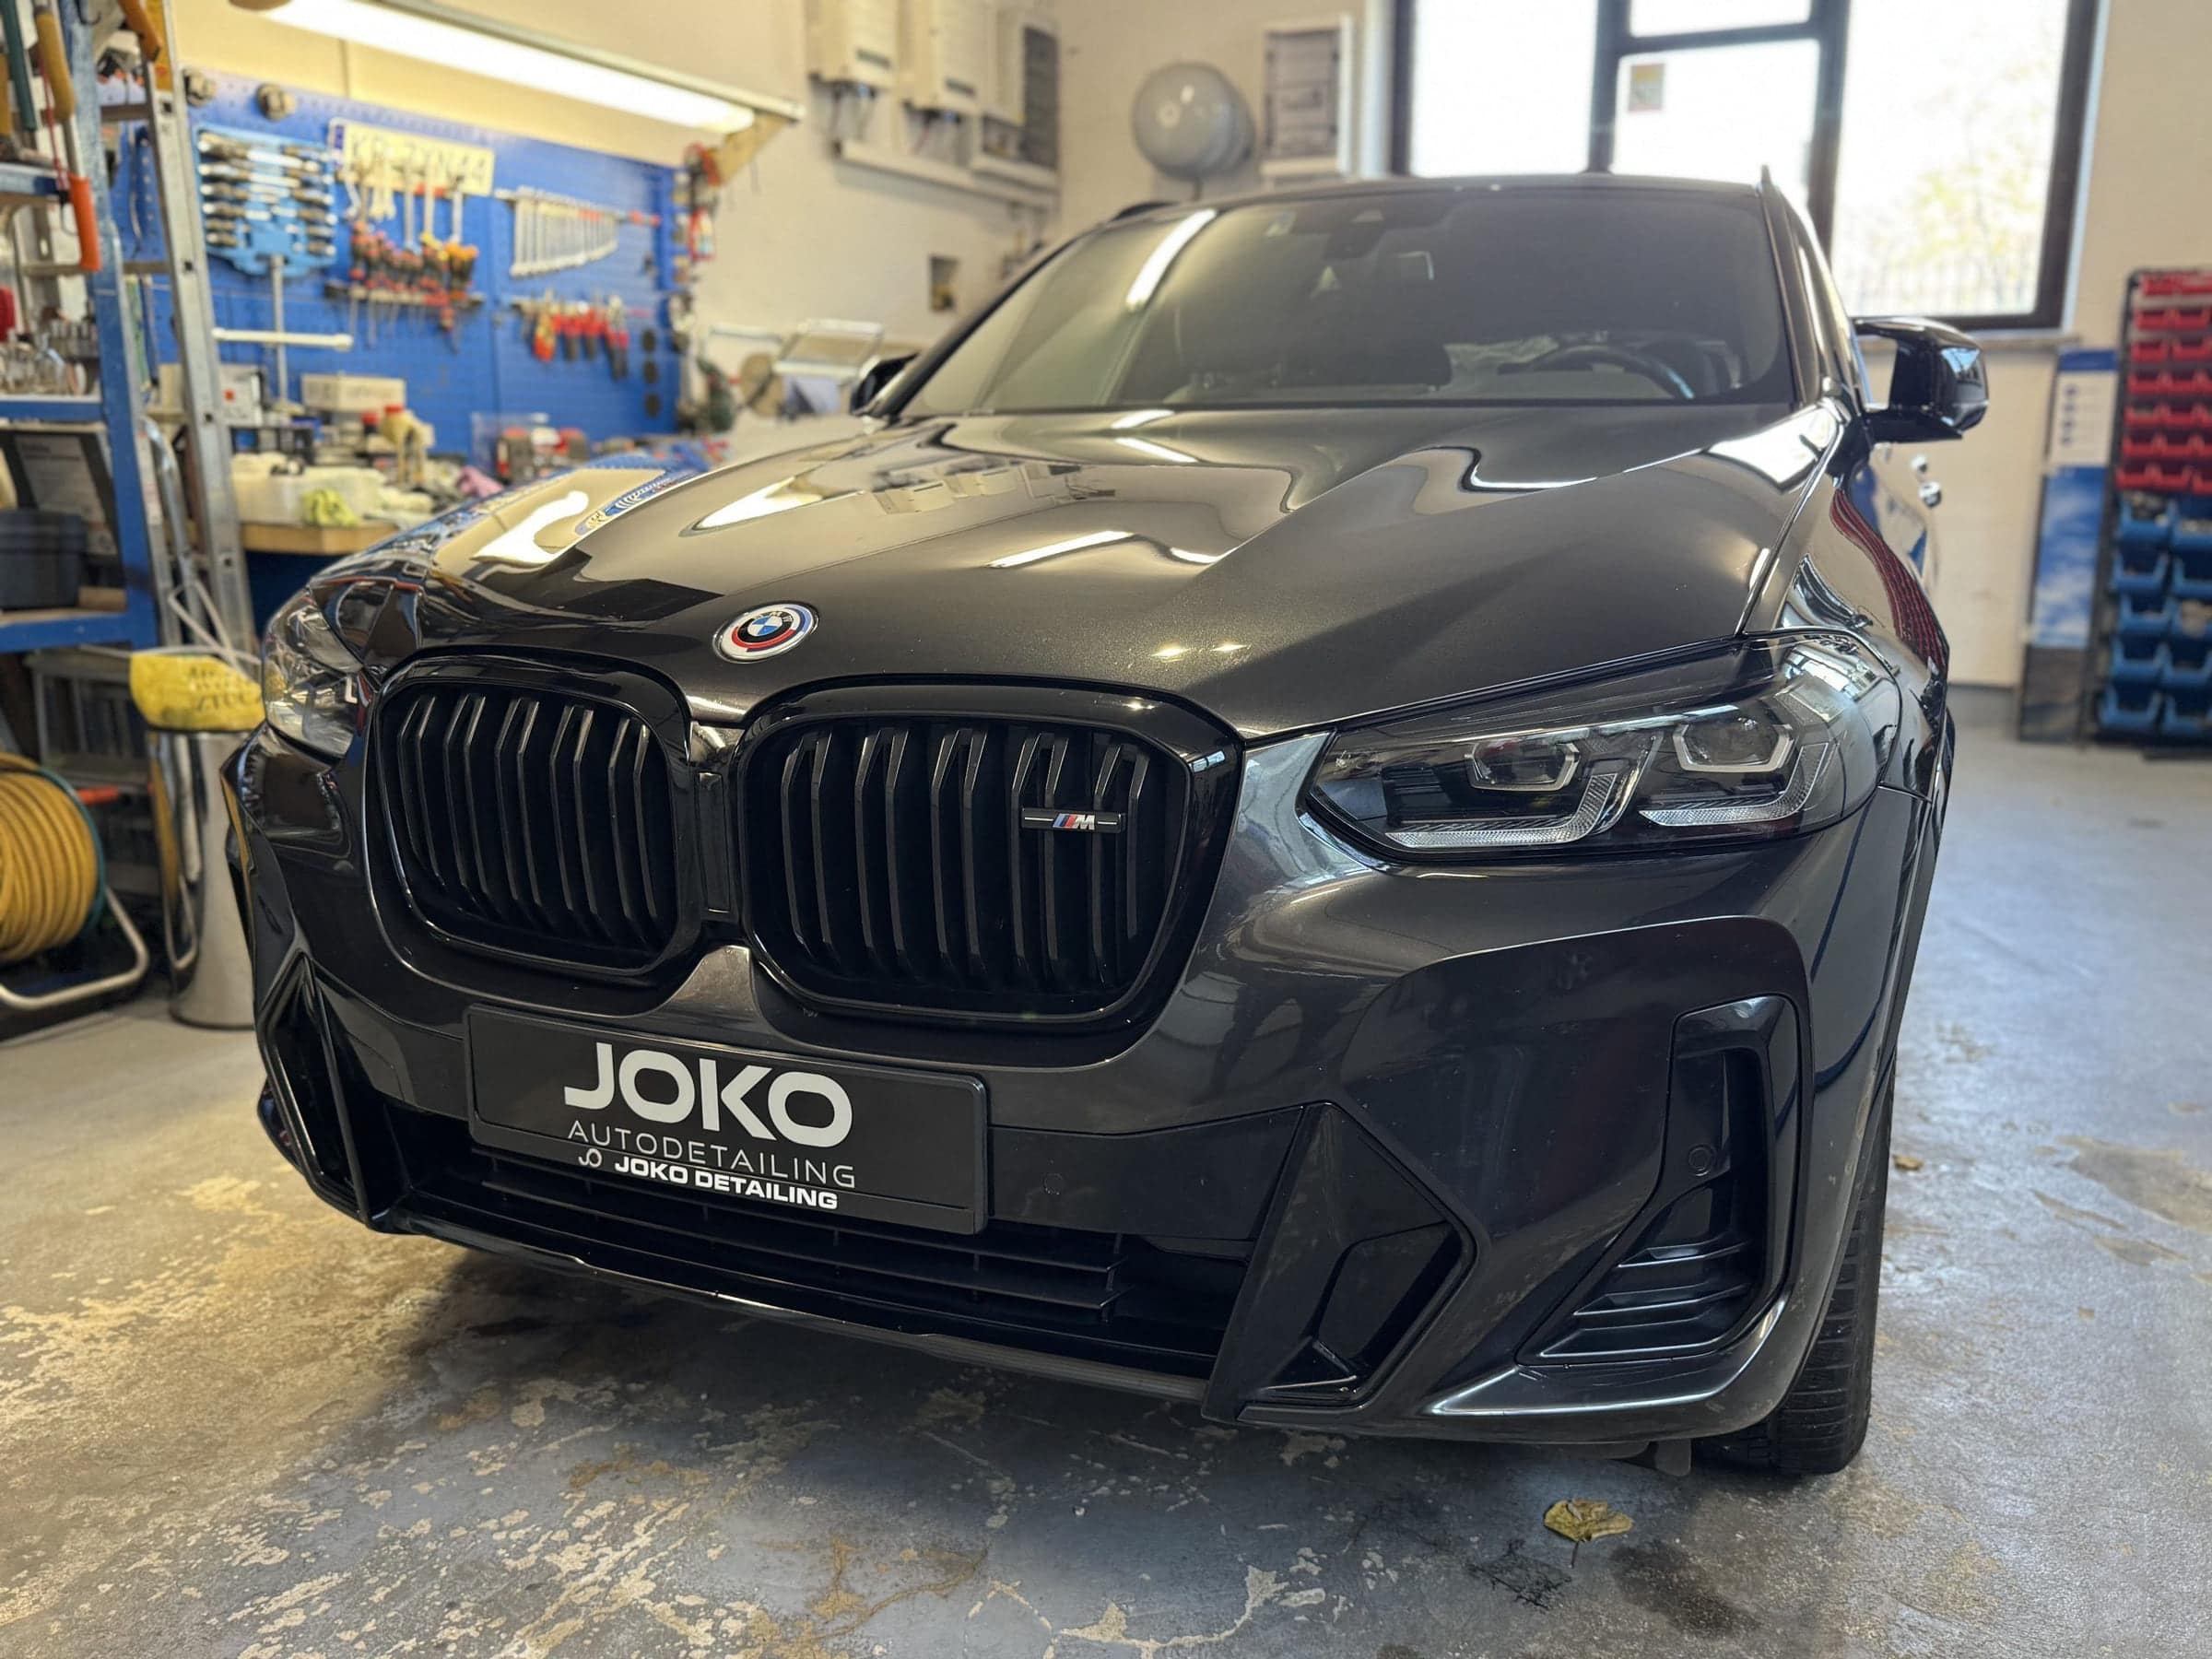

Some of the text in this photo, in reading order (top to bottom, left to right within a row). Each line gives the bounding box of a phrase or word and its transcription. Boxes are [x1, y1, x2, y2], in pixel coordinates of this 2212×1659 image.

[563, 1041, 853, 1148] JOKO
[567, 1120, 855, 1189] AUTODETAILING
[614, 1156, 688, 1184] JOKO
[694, 1170, 838, 1210] DETAILING
